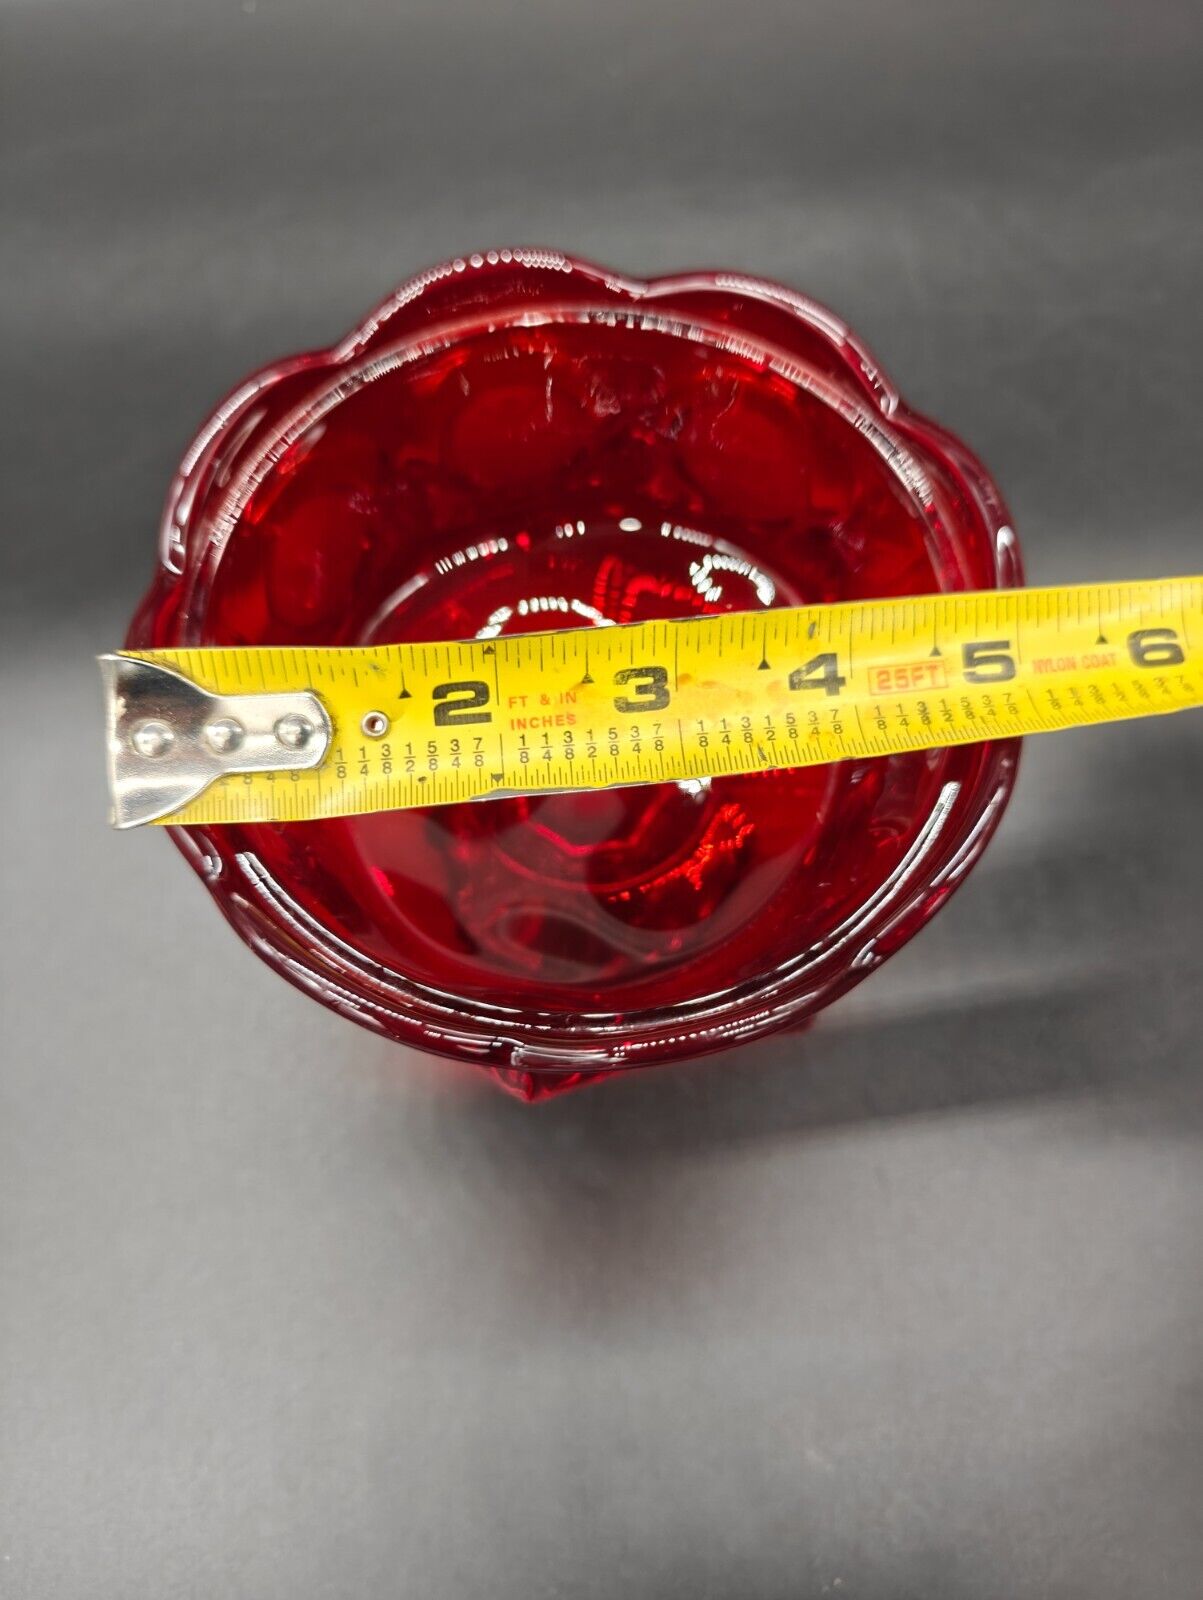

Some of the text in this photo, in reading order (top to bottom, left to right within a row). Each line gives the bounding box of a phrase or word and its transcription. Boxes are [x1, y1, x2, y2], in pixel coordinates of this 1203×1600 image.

[961, 640, 1016, 684] 5
[1032, 653, 1117, 674] NYLON COAT
[1127, 628, 1185, 669] 6
[613, 666, 671, 713] 3
[789, 653, 846, 696] 4
[876, 665, 938, 691] 25FT
[432, 680, 492, 726] 2
[507, 691, 577, 709] FT & IN
[510, 713, 577, 731] INCHES
